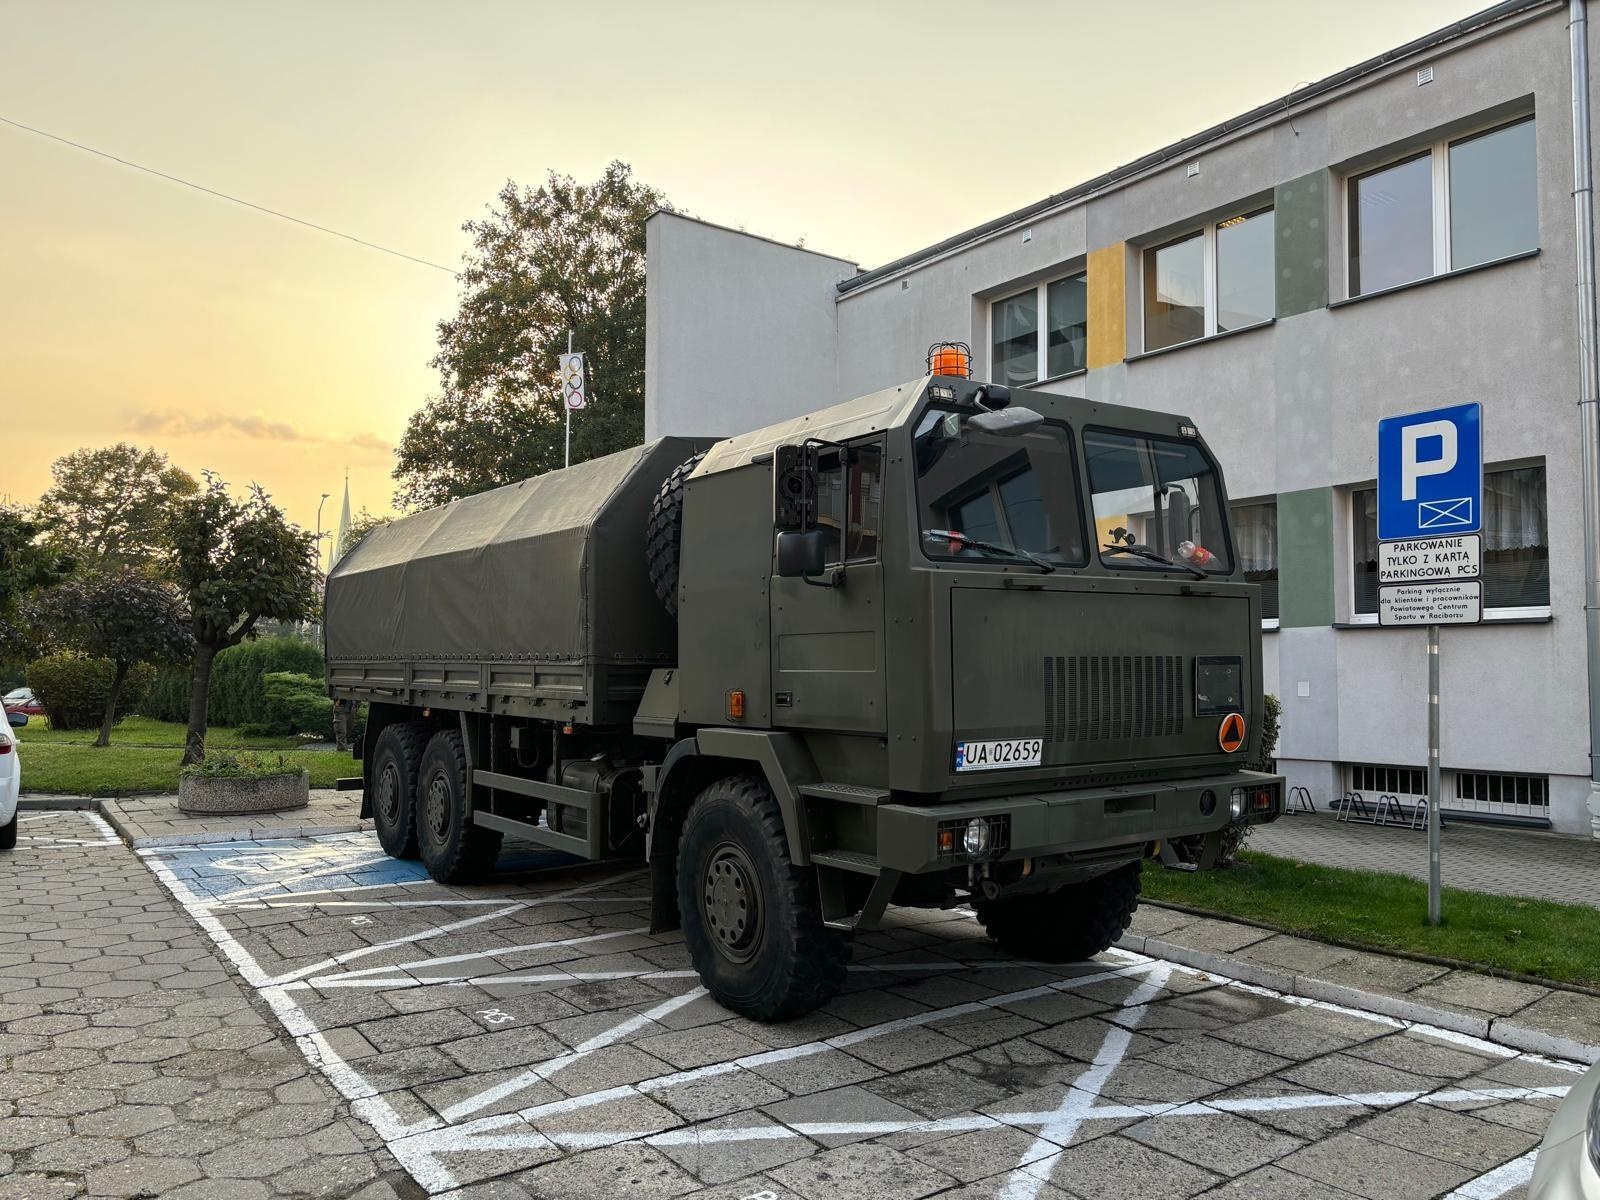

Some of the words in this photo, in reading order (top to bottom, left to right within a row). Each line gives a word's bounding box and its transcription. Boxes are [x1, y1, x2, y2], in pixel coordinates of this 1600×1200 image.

[1402, 420, 1458, 501] P
[1393, 538, 1463, 552] PARKOWANIE
[1387, 555, 1418, 566] TYLKO
[1423, 554, 1429, 564] Z
[1435, 551, 1470, 563] KARTĄ
[1380, 566, 1451, 579] PARKINGOWĄ
[1457, 564, 1478, 574] PCS
[1396, 588, 1422, 596] Parking
[1425, 586, 1461, 595] wyłącznie
[1394, 596, 1423, 604] klientów
[1432, 594, 1479, 603] pracowników
[966, 744, 988, 764] UA
[993, 741, 1041, 762] 02659
